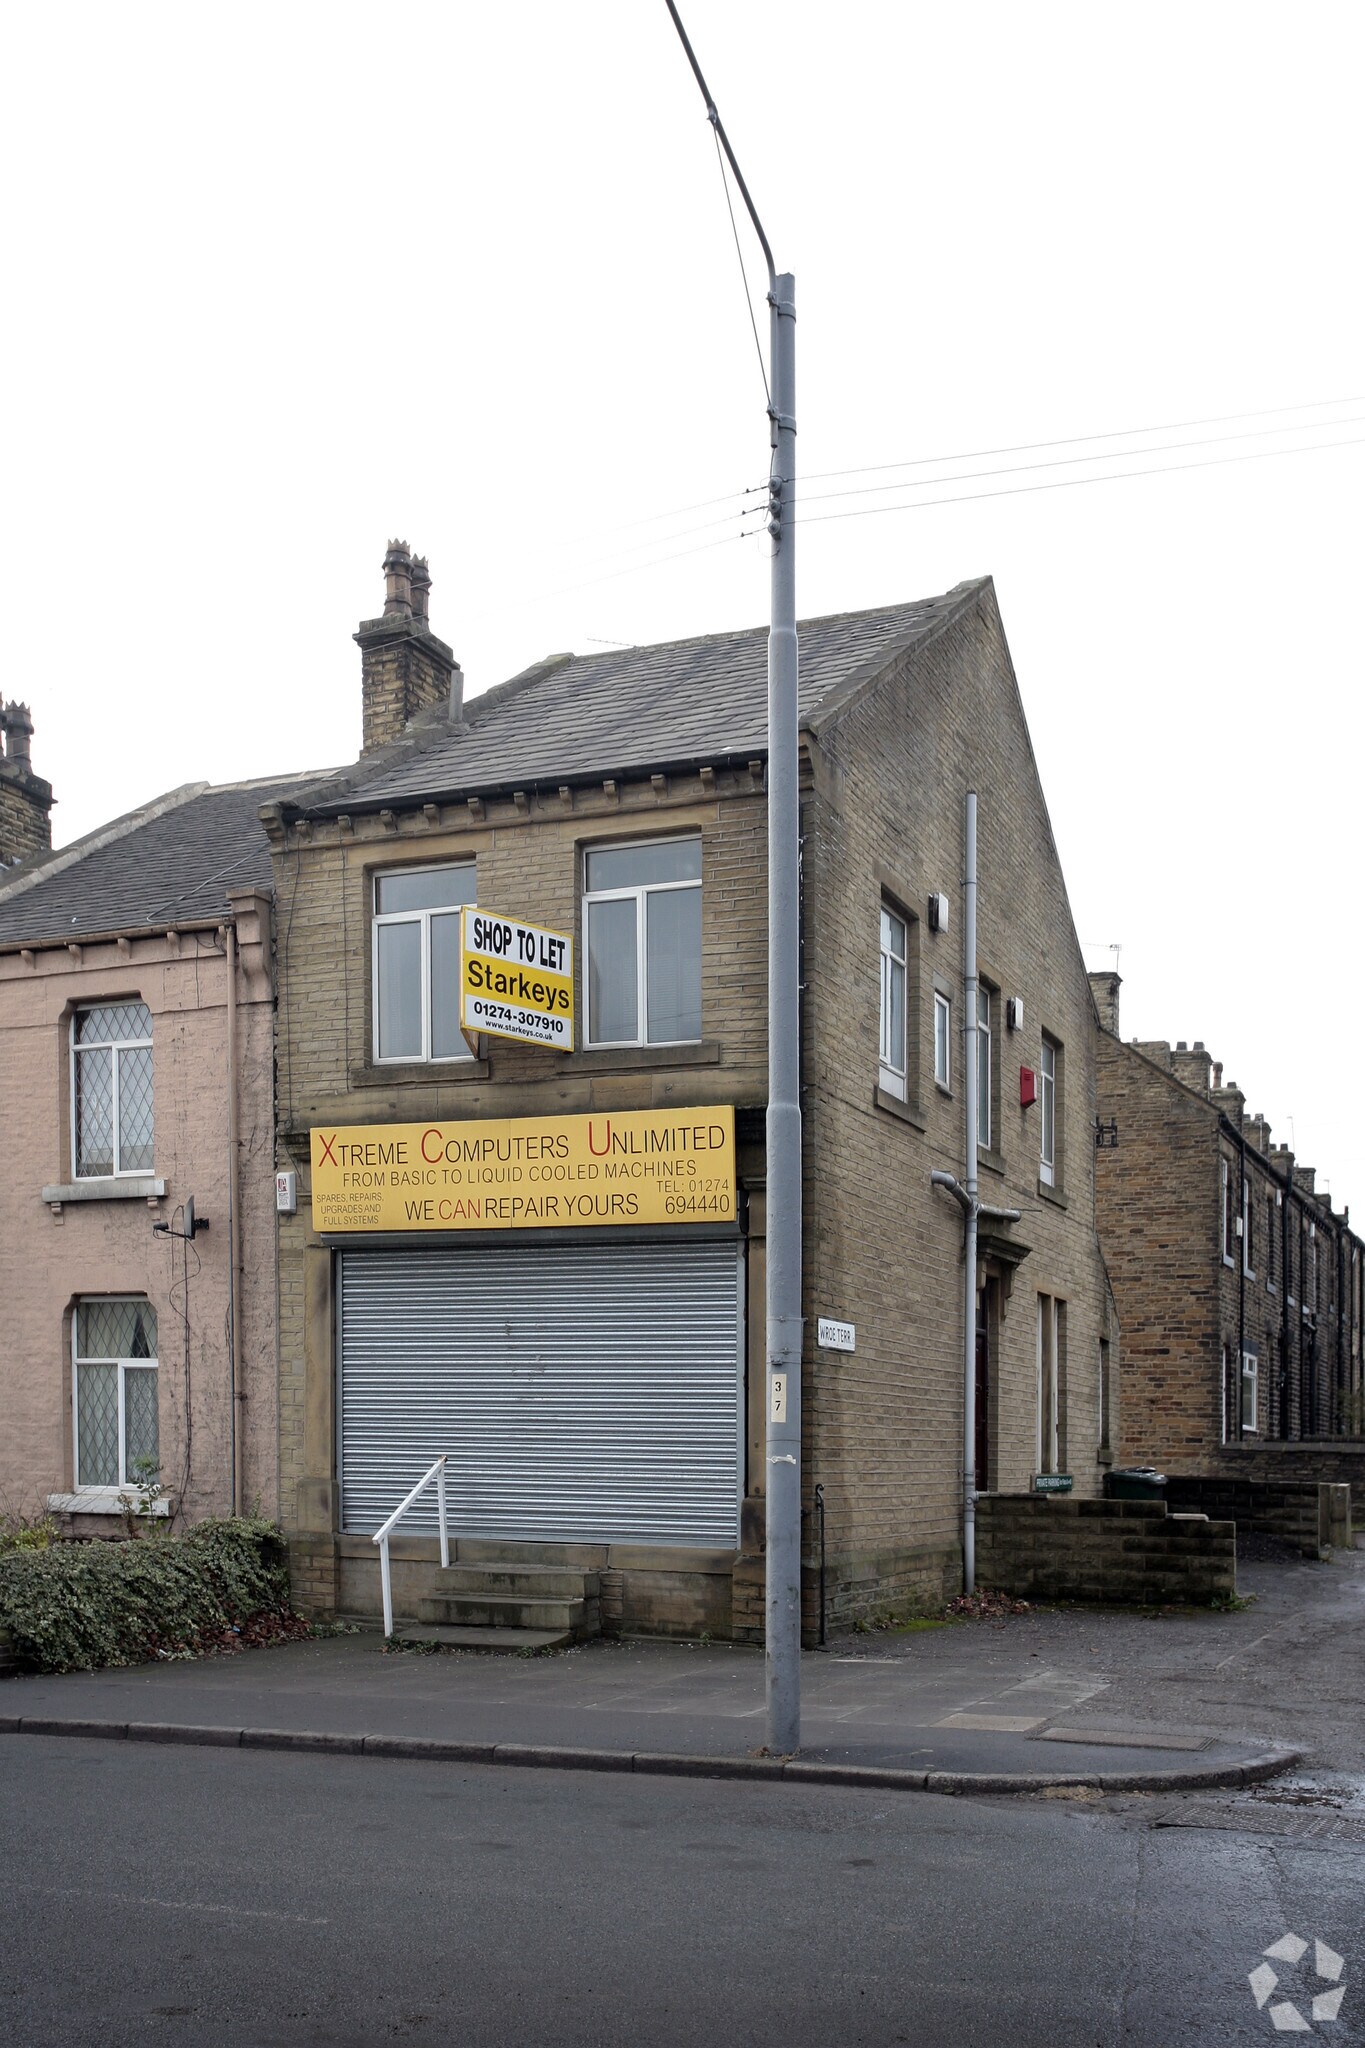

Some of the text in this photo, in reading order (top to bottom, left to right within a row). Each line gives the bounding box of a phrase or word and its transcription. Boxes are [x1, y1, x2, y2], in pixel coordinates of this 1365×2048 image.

[473, 917, 565, 971] SHOP TO LET
[467, 960, 570, 1010] Starkeys
[474, 1001, 564, 1033] 01274-307910
[485, 1020, 553, 1041] www.starkeys.co.uk
[318, 1120, 725, 1167] XTREME COMPUTERS UNLIMITED
[343, 1159, 697, 1187] FROM BASIC TO LIQUID COOLED MACHINES
[656, 1178, 729, 1193] TEL: 01274
[320, 1203, 381, 1214] UPGRADES AND
[404, 1193, 639, 1220] WE CAN REPAIR YOURS
[665, 1194, 730, 1215] 694440
[323, 1215, 379, 1225] FULL SYSTEMS
